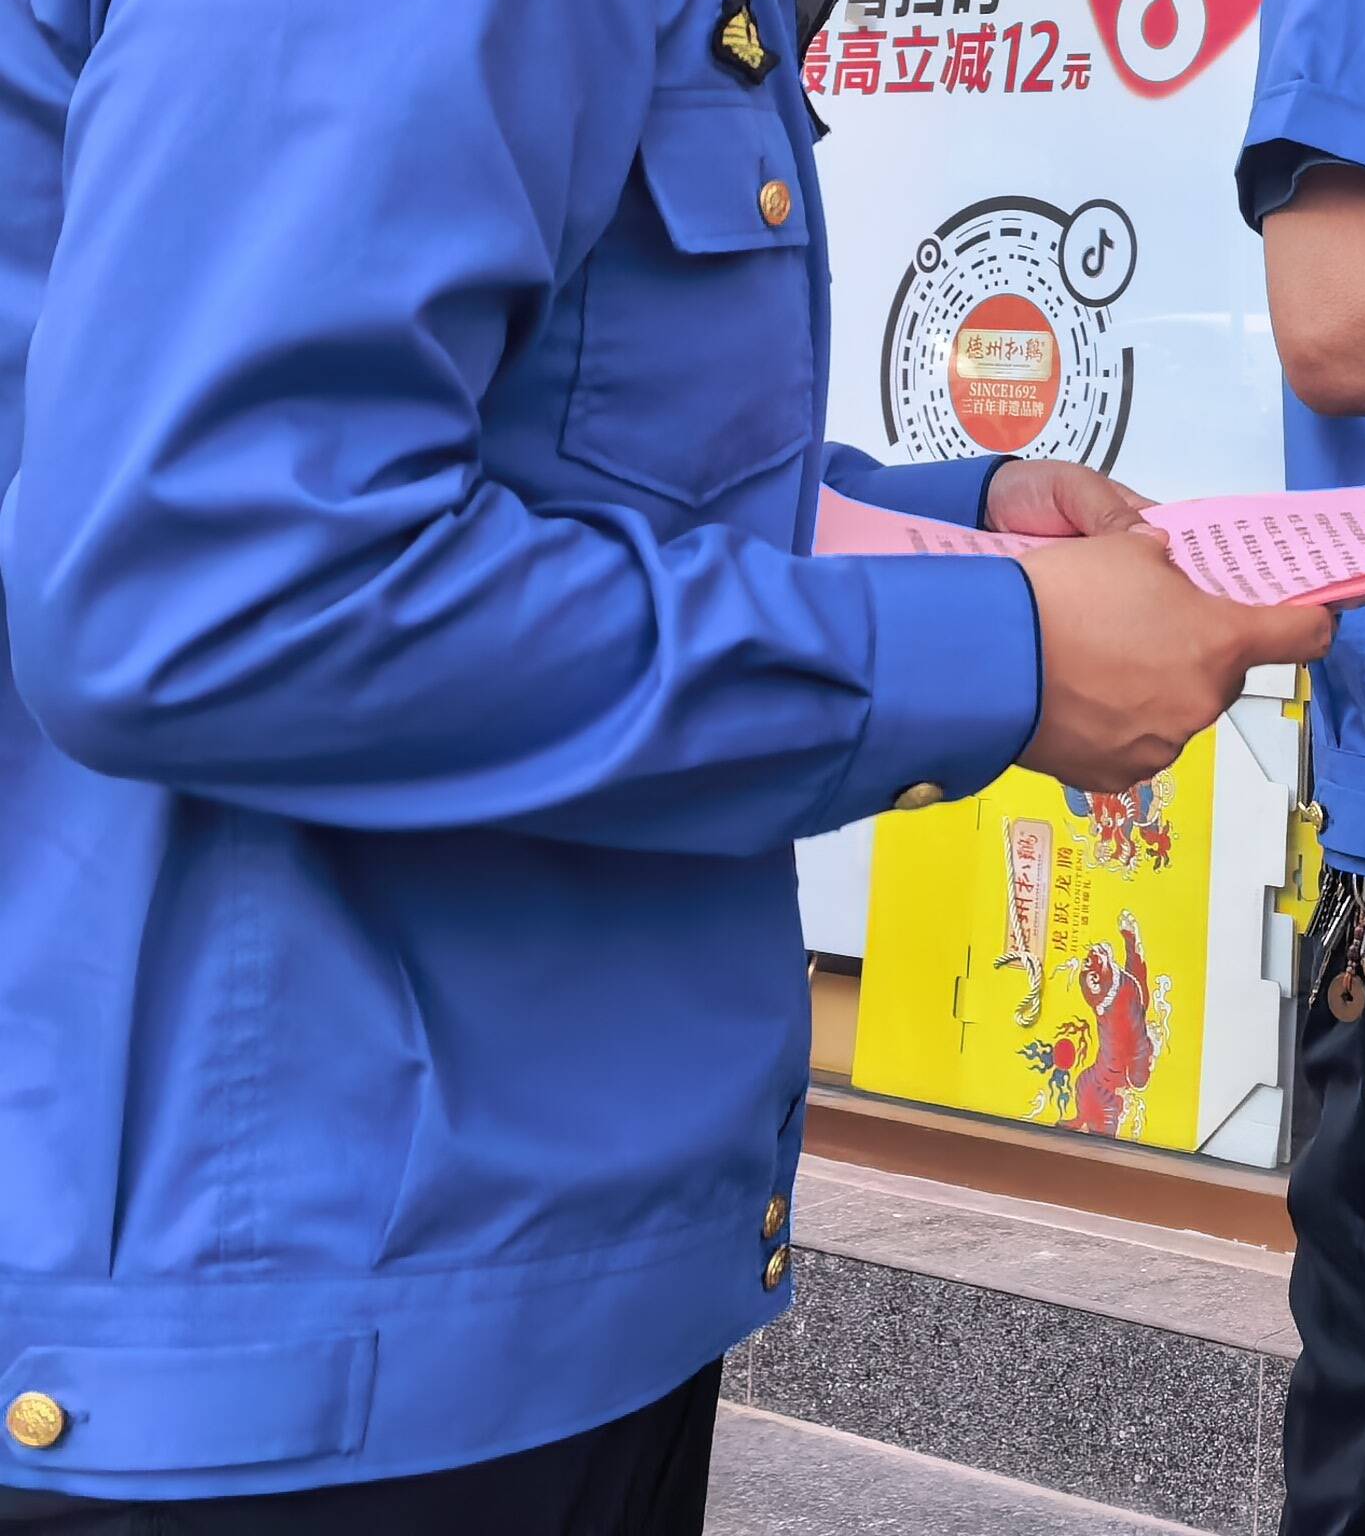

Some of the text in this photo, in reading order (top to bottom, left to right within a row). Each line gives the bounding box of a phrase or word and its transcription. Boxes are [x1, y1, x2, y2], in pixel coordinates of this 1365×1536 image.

[969, 382, 1037, 400] SINCE1692
[961, 399, 1044, 418] 三百年非遗品牌
[1052, 846, 1073, 953] 虎跃龙腾
